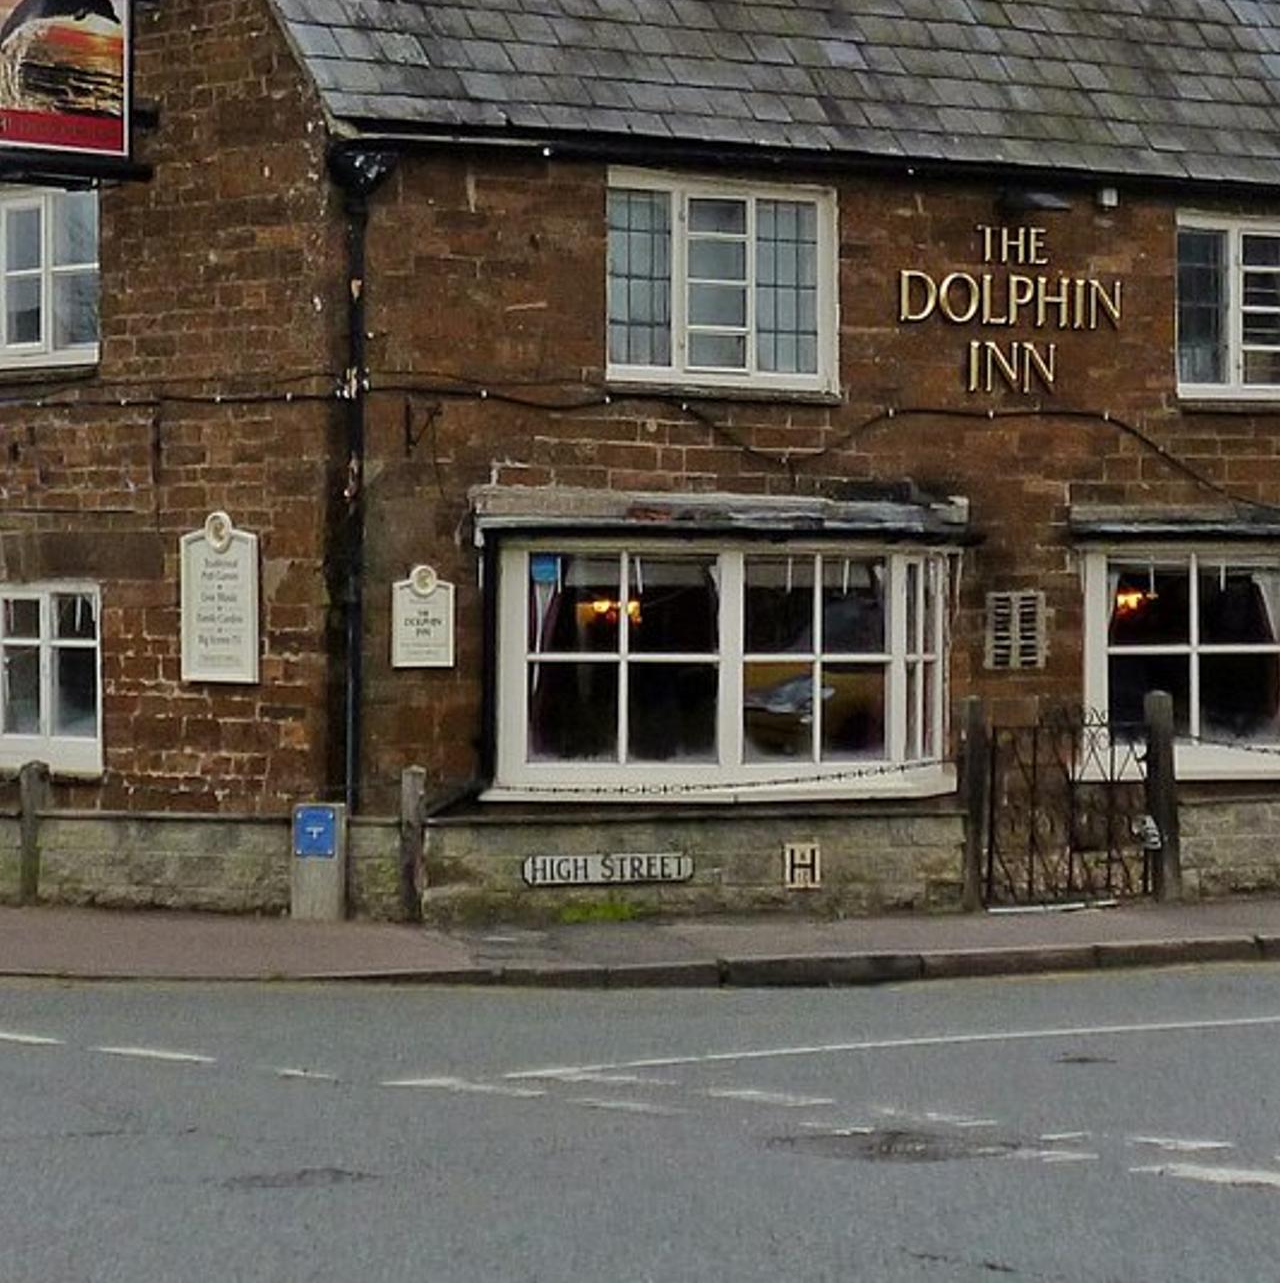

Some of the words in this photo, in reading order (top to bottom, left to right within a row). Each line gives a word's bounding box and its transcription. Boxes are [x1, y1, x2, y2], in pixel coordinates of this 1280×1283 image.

[977, 225, 1048, 264] THE
[900, 269, 1122, 329] DOLPHIN
[969, 341, 1056, 393] INN
[531, 857, 589, 882] HIGH
[600, 854, 683, 880] STREET
[790, 848, 816, 884] H
